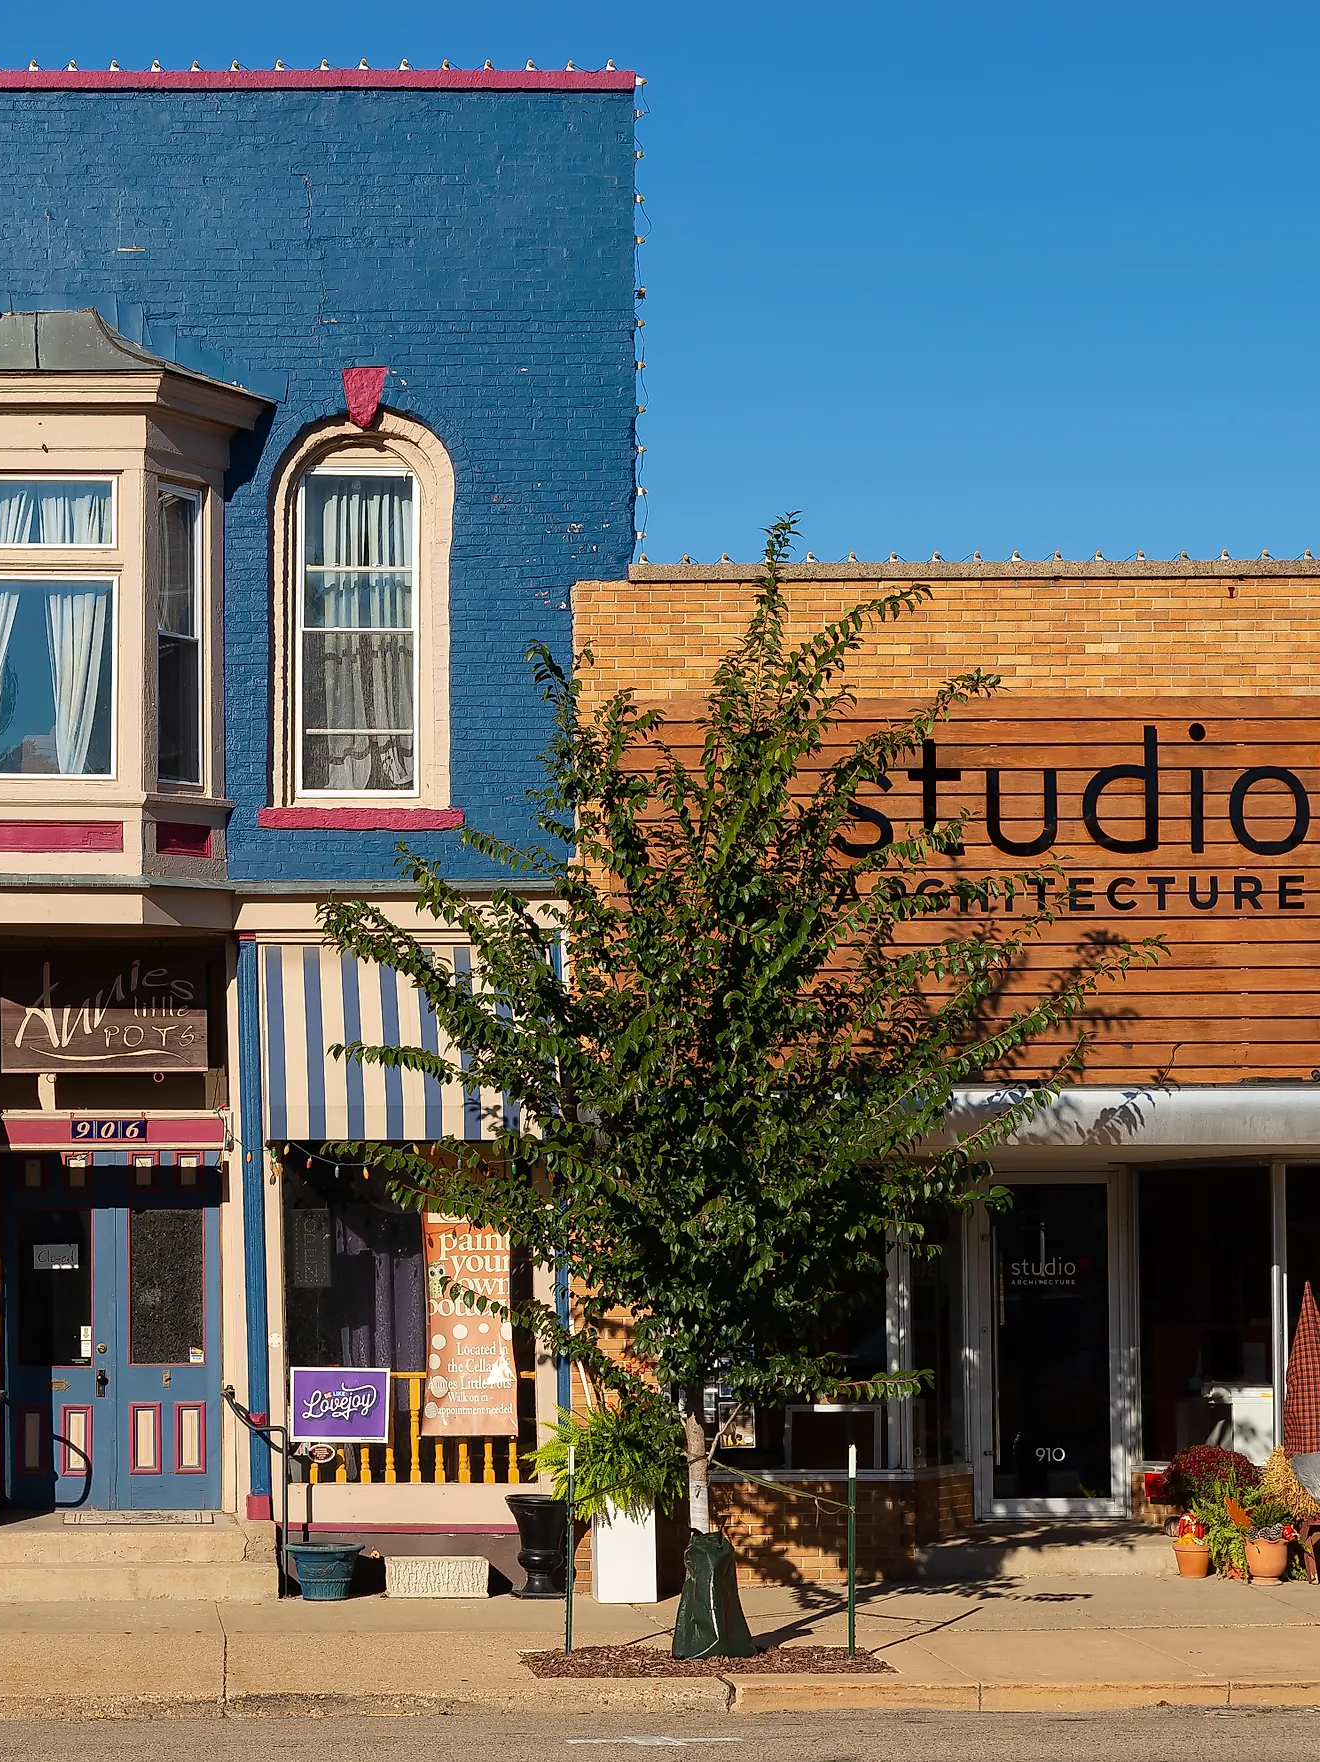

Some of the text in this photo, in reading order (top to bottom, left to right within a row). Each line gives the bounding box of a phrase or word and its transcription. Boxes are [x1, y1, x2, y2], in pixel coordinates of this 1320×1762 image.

[831, 723, 1310, 858] studio
[103, 1025, 195, 1048] POTS
[76, 1121, 140, 1139] 906
[438, 1230, 511, 1261] paint
[1011, 1256, 1076, 1276] studio
[456, 1341, 496, 1356] Located
[447, 1359, 463, 1373] the
[302, 1382, 377, 1420] Lovejoy
[447, 1391, 467, 1402] Walk
[469, 1394, 479, 1402] on
[480, 1392, 489, 1402] in
[437, 1403, 513, 1417] appointment needed
[1035, 1447, 1066, 1462] 910
